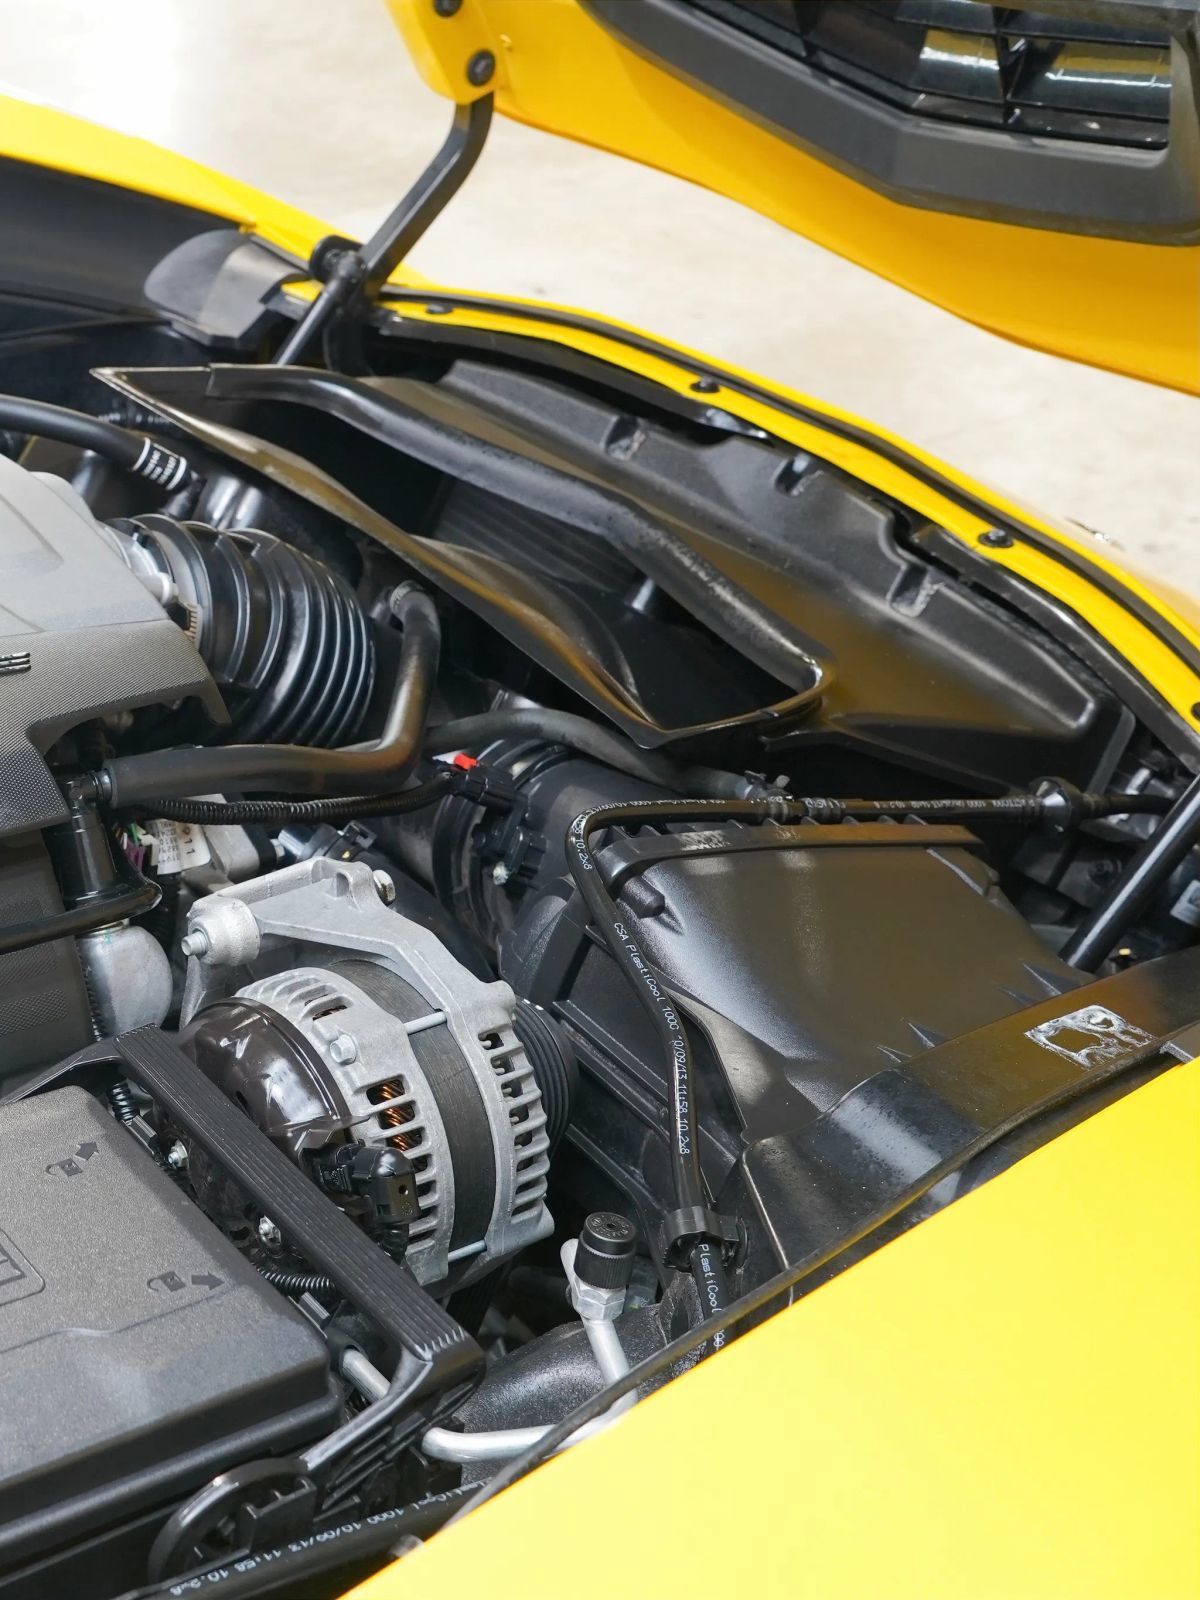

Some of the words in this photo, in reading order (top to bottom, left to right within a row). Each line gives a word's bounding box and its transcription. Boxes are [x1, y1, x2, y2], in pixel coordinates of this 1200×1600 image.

[575, 838, 593, 870] 10.2x8
[614, 922, 630, 941] CSA
[626, 944, 666, 1002] PlastiCool
[678, 1082, 689, 1114] 11:58
[679, 1120, 690, 1155] 10.2x8
[699, 1244, 723, 1313] PlastiCool
[412, 1476, 492, 1510] lastiCool
[367, 1508, 404, 1525] 1000
